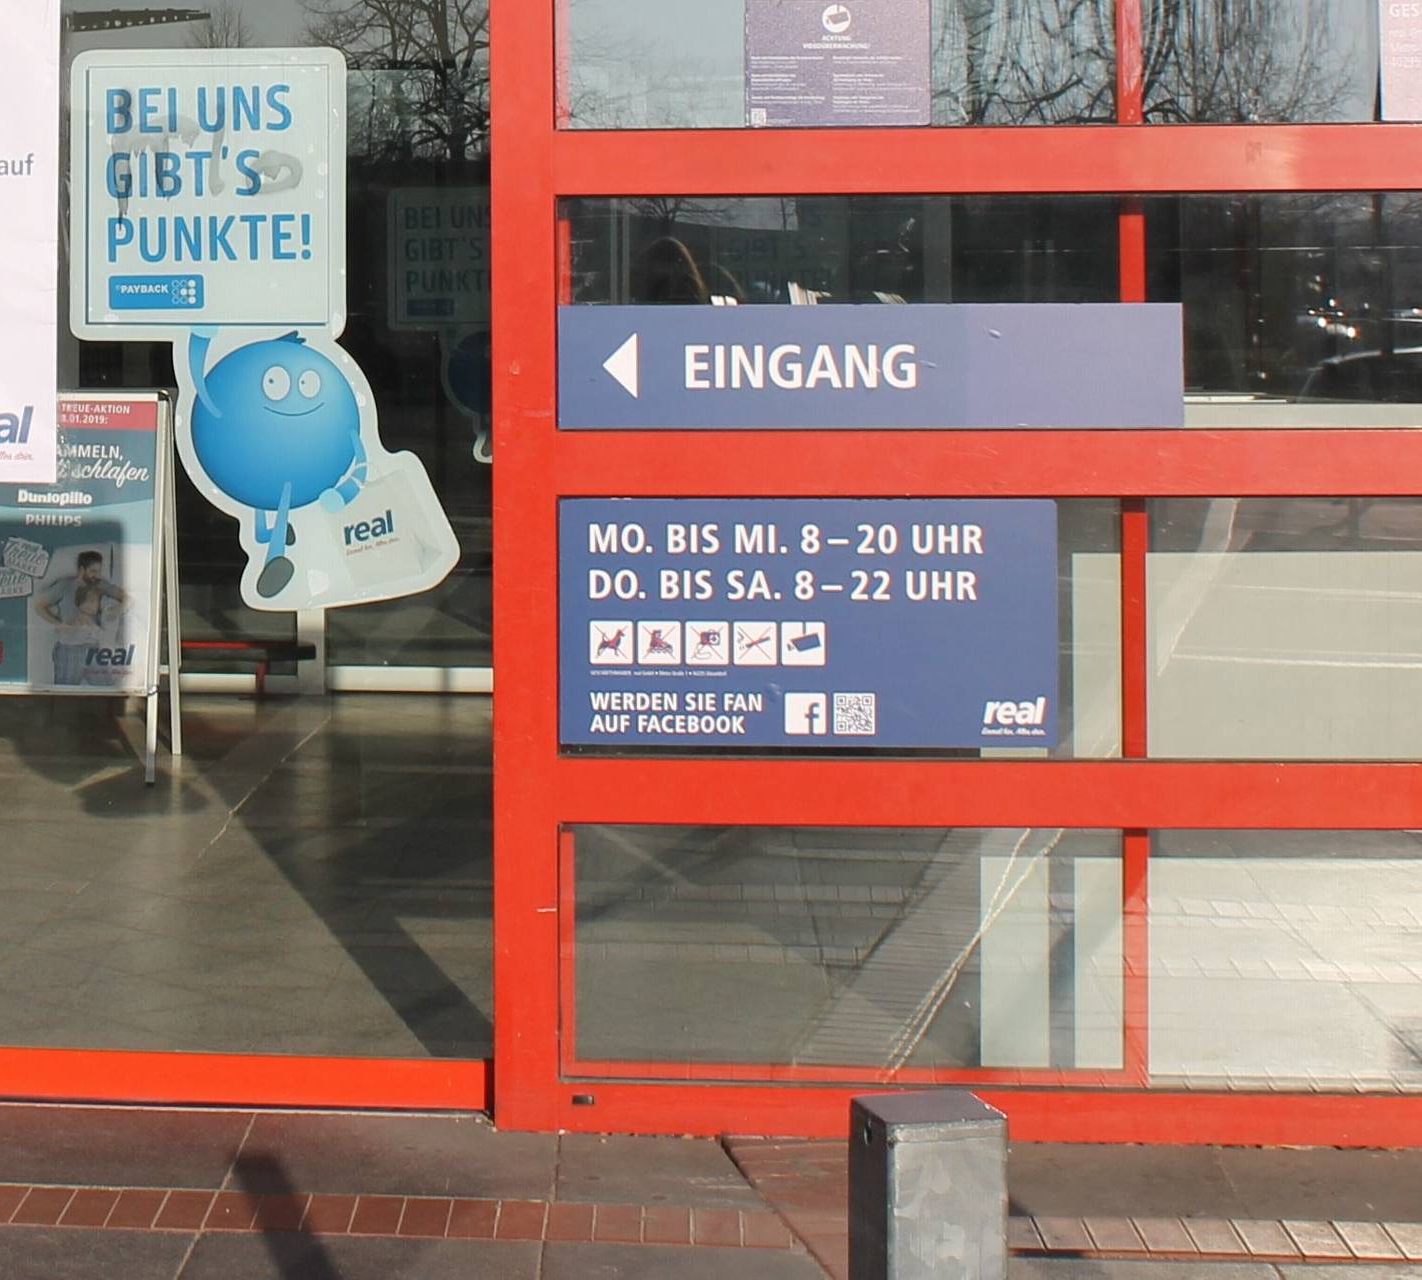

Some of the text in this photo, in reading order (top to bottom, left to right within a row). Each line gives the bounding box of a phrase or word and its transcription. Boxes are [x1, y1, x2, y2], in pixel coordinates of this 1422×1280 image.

[1389, 3, 1422, 17] GES
[105, 84, 292, 135] BEI UNS
[106, 149, 262, 199] GIBT'S
[451, 206, 490, 228] UN
[107, 213, 313, 263] PUNKTE!
[405, 269, 489, 293] PUNKT
[683, 343, 918, 389] EINGANG
[18, 489, 93, 506] Dunlopillo
[25, 514, 83, 527] PHILIPS
[344, 509, 394, 545] real
[588, 523, 653, 554] MO.
[666, 523, 721, 554] BIS
[734, 524, 788, 554] MI.
[912, 524, 985, 555] UHR
[588, 569, 646, 600] DO.
[659, 569, 714, 600] BIS
[727, 569, 782, 600] SA.
[905, 570, 978, 601] UHR
[85, 644, 135, 666] real
[590, 692, 763, 712] WERDEN SIE FAN
[983, 696, 1046, 725] real
[590, 715, 746, 734] AUF FACEBOOK
